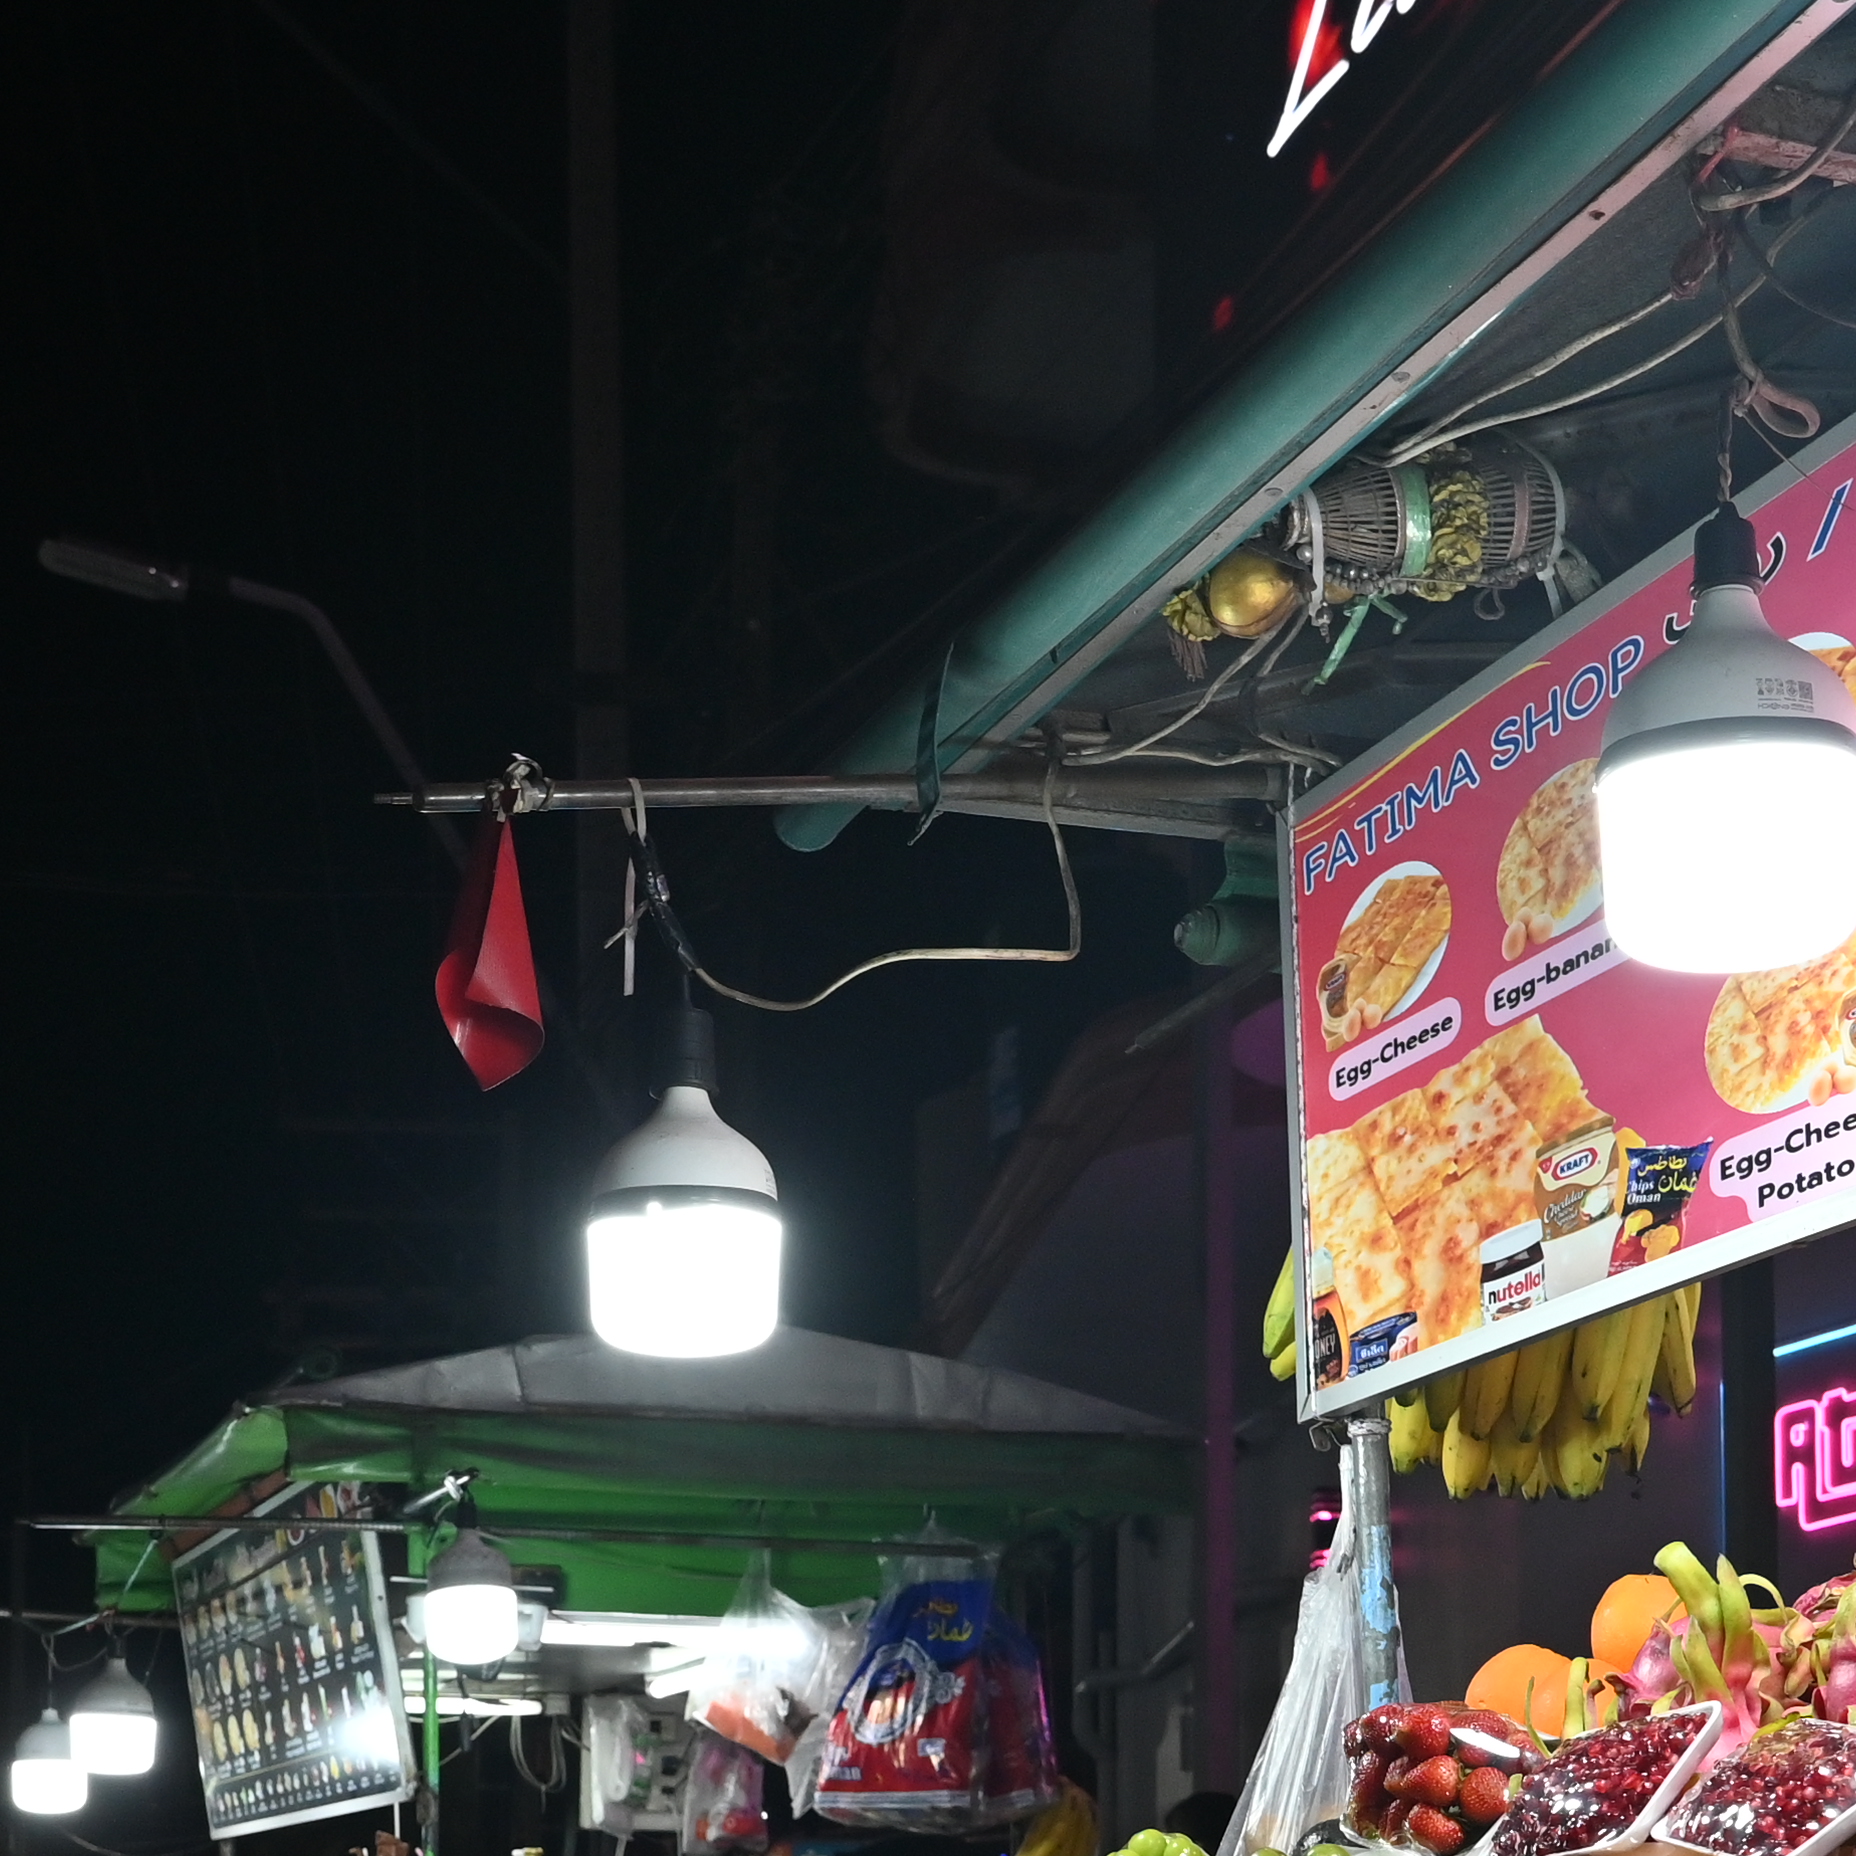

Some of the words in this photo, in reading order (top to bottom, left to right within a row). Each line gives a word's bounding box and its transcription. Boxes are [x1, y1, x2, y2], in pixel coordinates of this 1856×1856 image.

[1300, 750, 1478, 895] FATIMA
[1491, 634, 1645, 769] SHOP
[1334, 1013, 1454, 1090] Egg-Cheese
[1559, 1153, 1591, 1174] KRAFT
[1757, 1157, 1856, 1210] Potato
[1488, 1270, 1542, 1306] nutella
